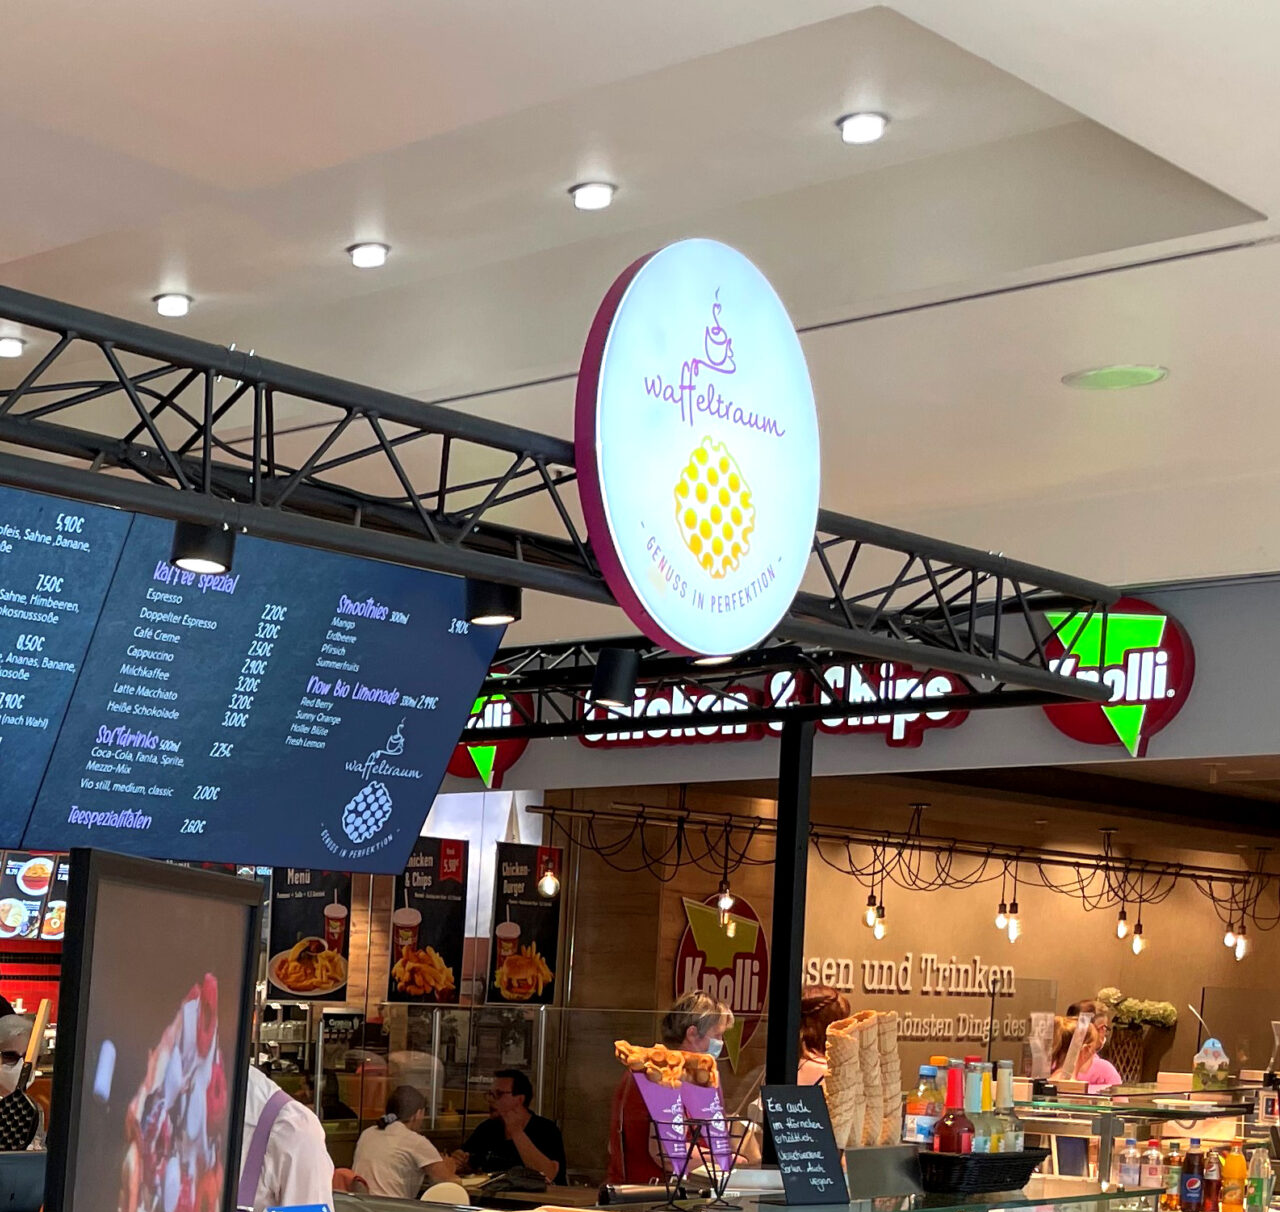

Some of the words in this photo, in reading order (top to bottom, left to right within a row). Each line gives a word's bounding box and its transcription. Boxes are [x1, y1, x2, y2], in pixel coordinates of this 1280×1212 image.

[645, 359, 785, 438] waffeltraum
[646, 537, 687, 599] GENUSS
[692, 588, 705, 611] IN
[710, 564, 777, 614] PERFEKTION
[30, 594, 80, 614] Himbeeren,
[146, 588, 183, 605] Espresso
[337, 594, 389, 621] Smoothies
[140, 607, 182, 625] Doppelter
[182, 614, 218, 630] Espresso
[5, 652, 40, 669] Ananas,
[41, 656, 76, 673] Banane,
[127, 645, 174, 662] Cappuccino
[119, 663, 170, 681] Milchkaffee
[113, 682, 135, 695] Latte
[135, 686, 178, 700] Macchiato
[333, 679, 350, 697] Bio
[352, 682, 400, 706] Limonade
[133, 704, 180, 720] Schokolade
[96, 725, 159, 749] Softdrinks
[91, 747, 134, 761] Coca-Cola,
[345, 751, 423, 781] waffeltraum
[802, 957, 854, 990] sen
[862, 953, 913, 991] und
[920, 953, 1015, 993] Trinken
[957, 1014, 998, 1041] Dinge
[1002, 1013, 1025, 1035] des
